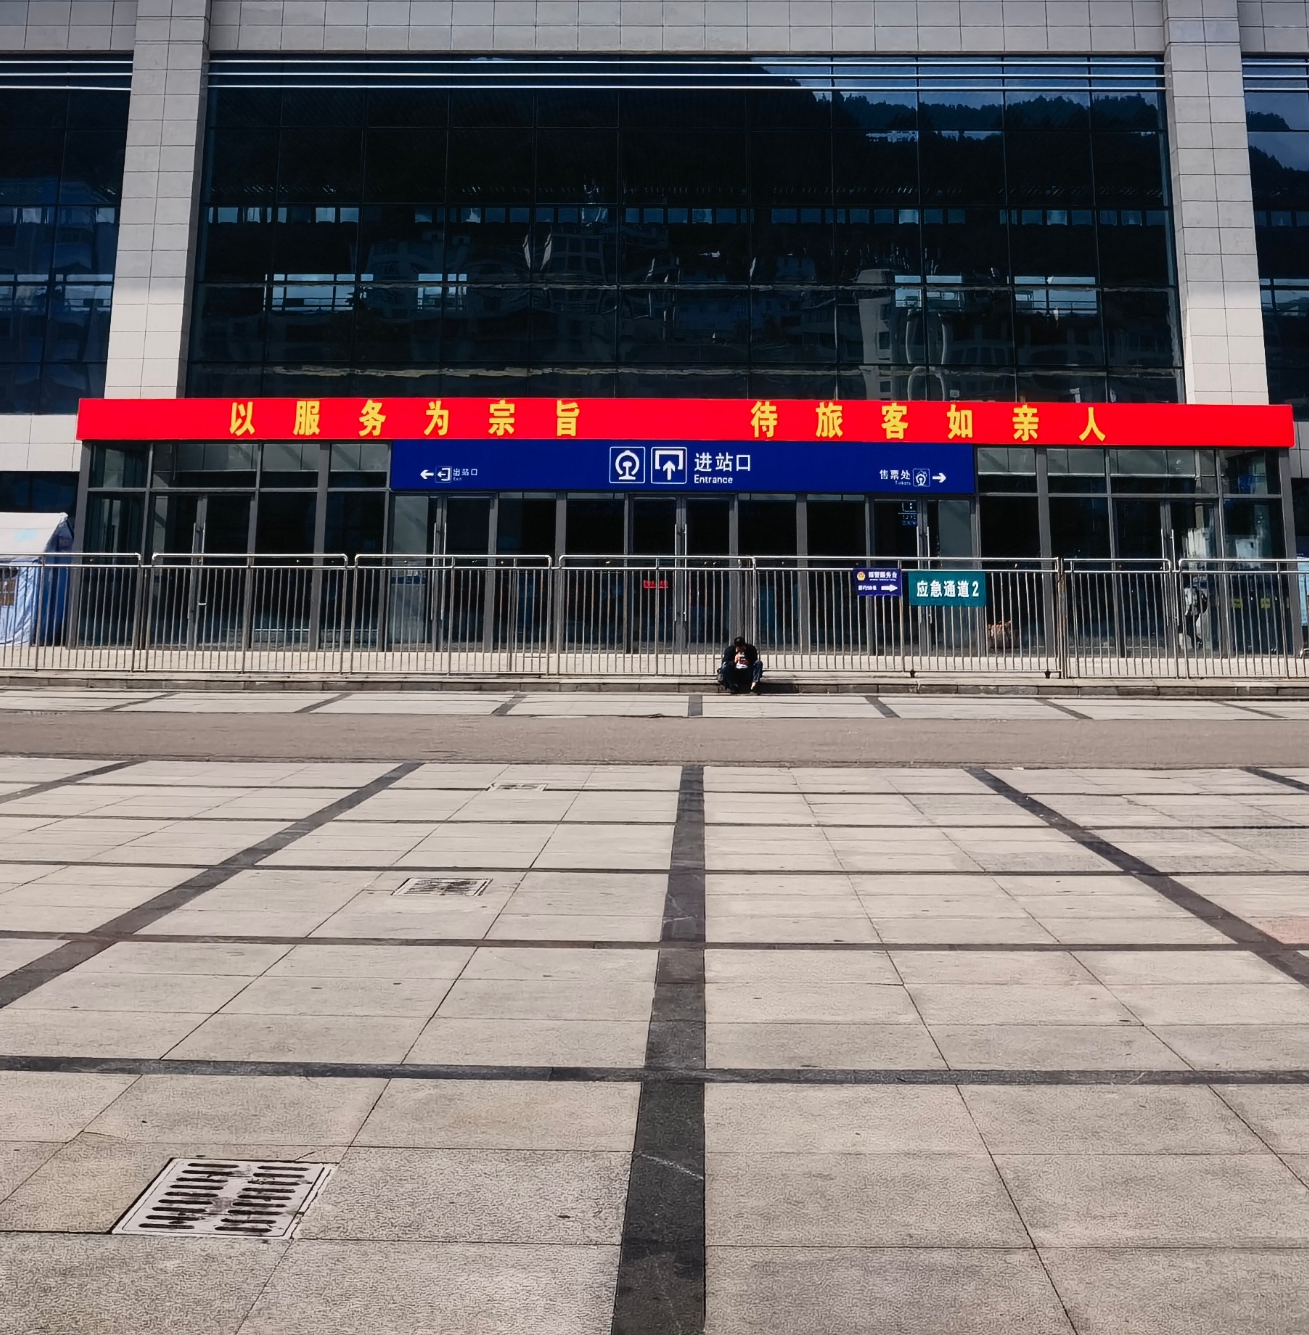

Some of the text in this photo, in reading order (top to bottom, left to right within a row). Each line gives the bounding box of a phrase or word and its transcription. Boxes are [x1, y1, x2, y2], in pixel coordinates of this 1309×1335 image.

[229, 399, 1107, 442] 以服务为宗旨 待旅客如亲人
[694, 452, 752, 472] 进站口
[452, 468, 478, 477] 出站口
[693, 474, 733, 484] Entrance
[879, 469, 911, 480] 售票处
[916, 580, 979, 598] 应急通道2
